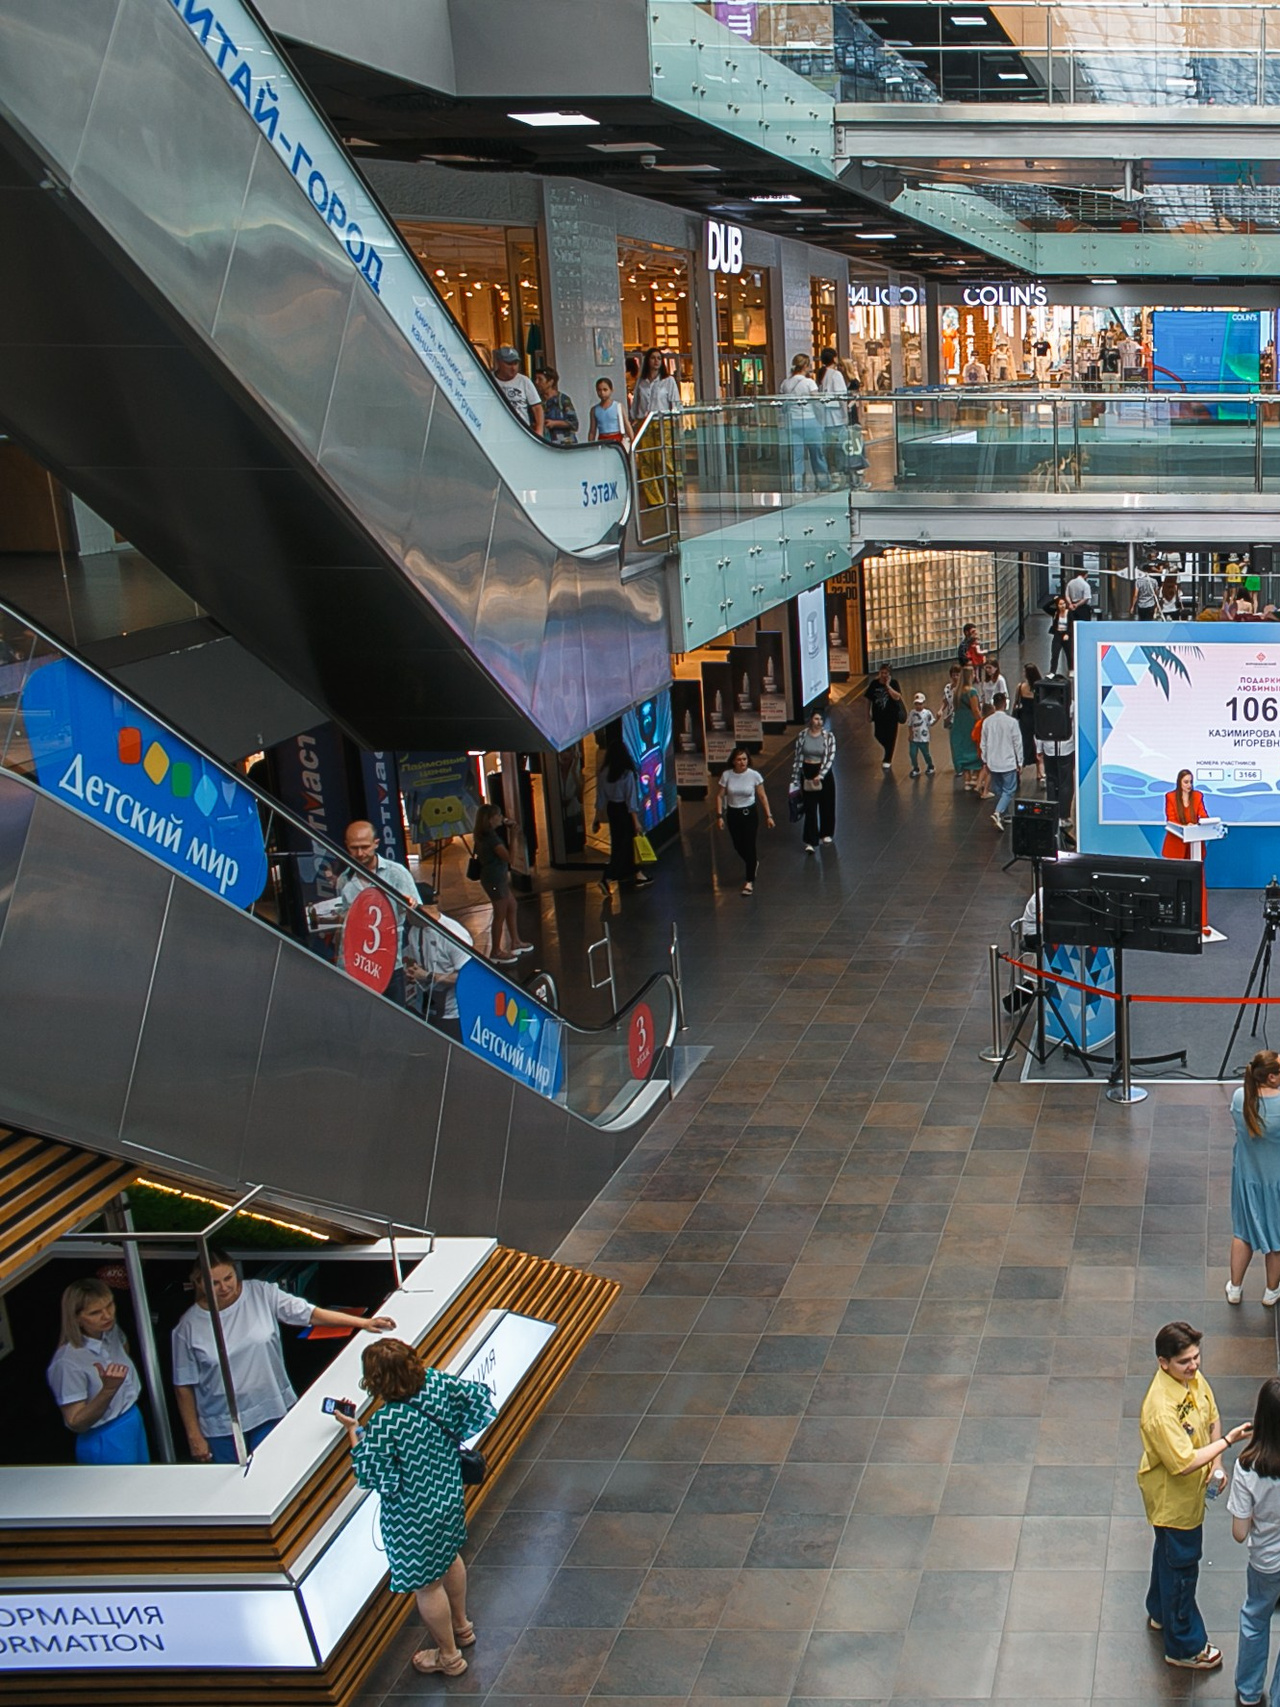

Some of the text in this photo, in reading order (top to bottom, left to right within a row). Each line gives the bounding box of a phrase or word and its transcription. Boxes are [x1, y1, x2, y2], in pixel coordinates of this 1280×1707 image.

[174, 0, 381, 296] ИТАЙ-ГОРОД
[708, 221, 742, 273] DUB
[963, 284, 1048, 306] COLIN'S
[1232, 313, 1258, 321] COLIN'S
[581, 481, 619, 507] 3 этаж
[1208, 729, 1276, 738] КАЗИМИРОВА
[58, 753, 239, 895] Детский мир
[362, 905, 383, 955] 3
[353, 952, 382, 980] этаж
[636, 1015, 646, 1052] 3
[470, 1016, 551, 1097] Детский мир
